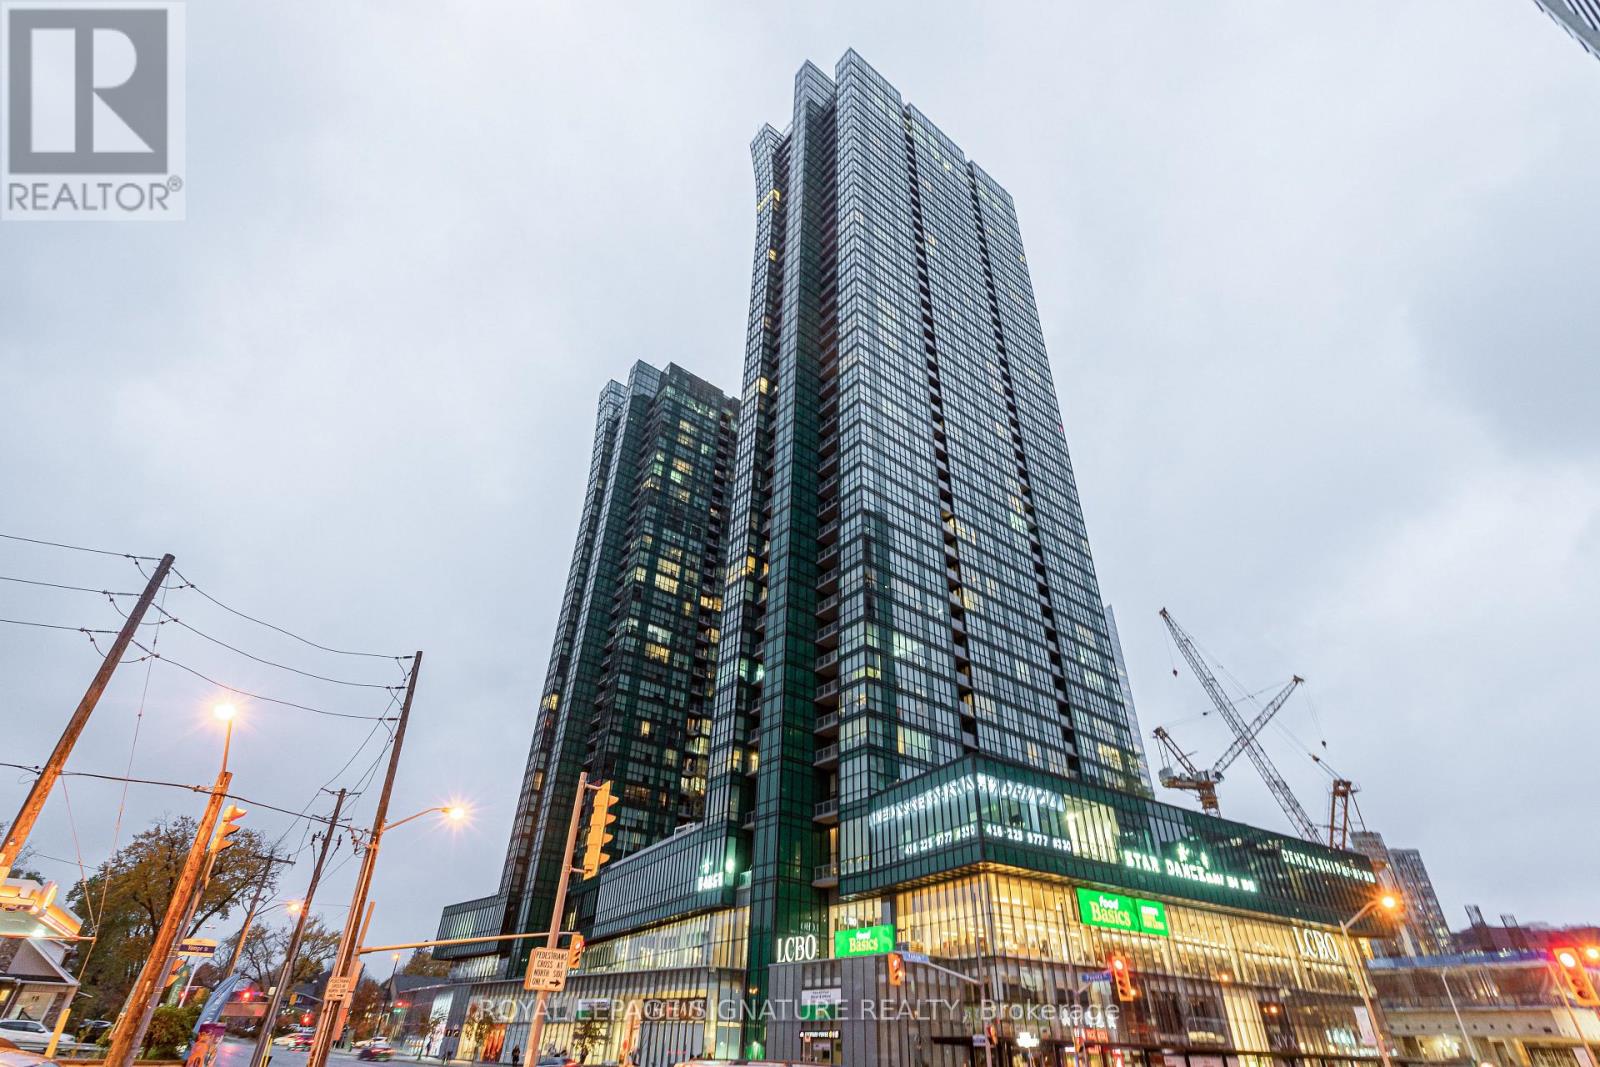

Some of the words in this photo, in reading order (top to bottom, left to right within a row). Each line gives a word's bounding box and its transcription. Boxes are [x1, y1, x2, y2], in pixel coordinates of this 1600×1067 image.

[1124, 850, 1160, 873] STAR
[1099, 895, 1119, 910] food
[1089, 901, 1131, 928] Basics
[776, 934, 817, 963] LCBO
[849, 937, 879, 953] Basics
[1292, 926, 1339, 962] LCBO
[537, 951, 568, 961] PEDESTRIANS
[537, 960, 553, 969] CROSS
[534, 969, 550, 977] NORTH
[531, 978, 546, 986] ONLY
